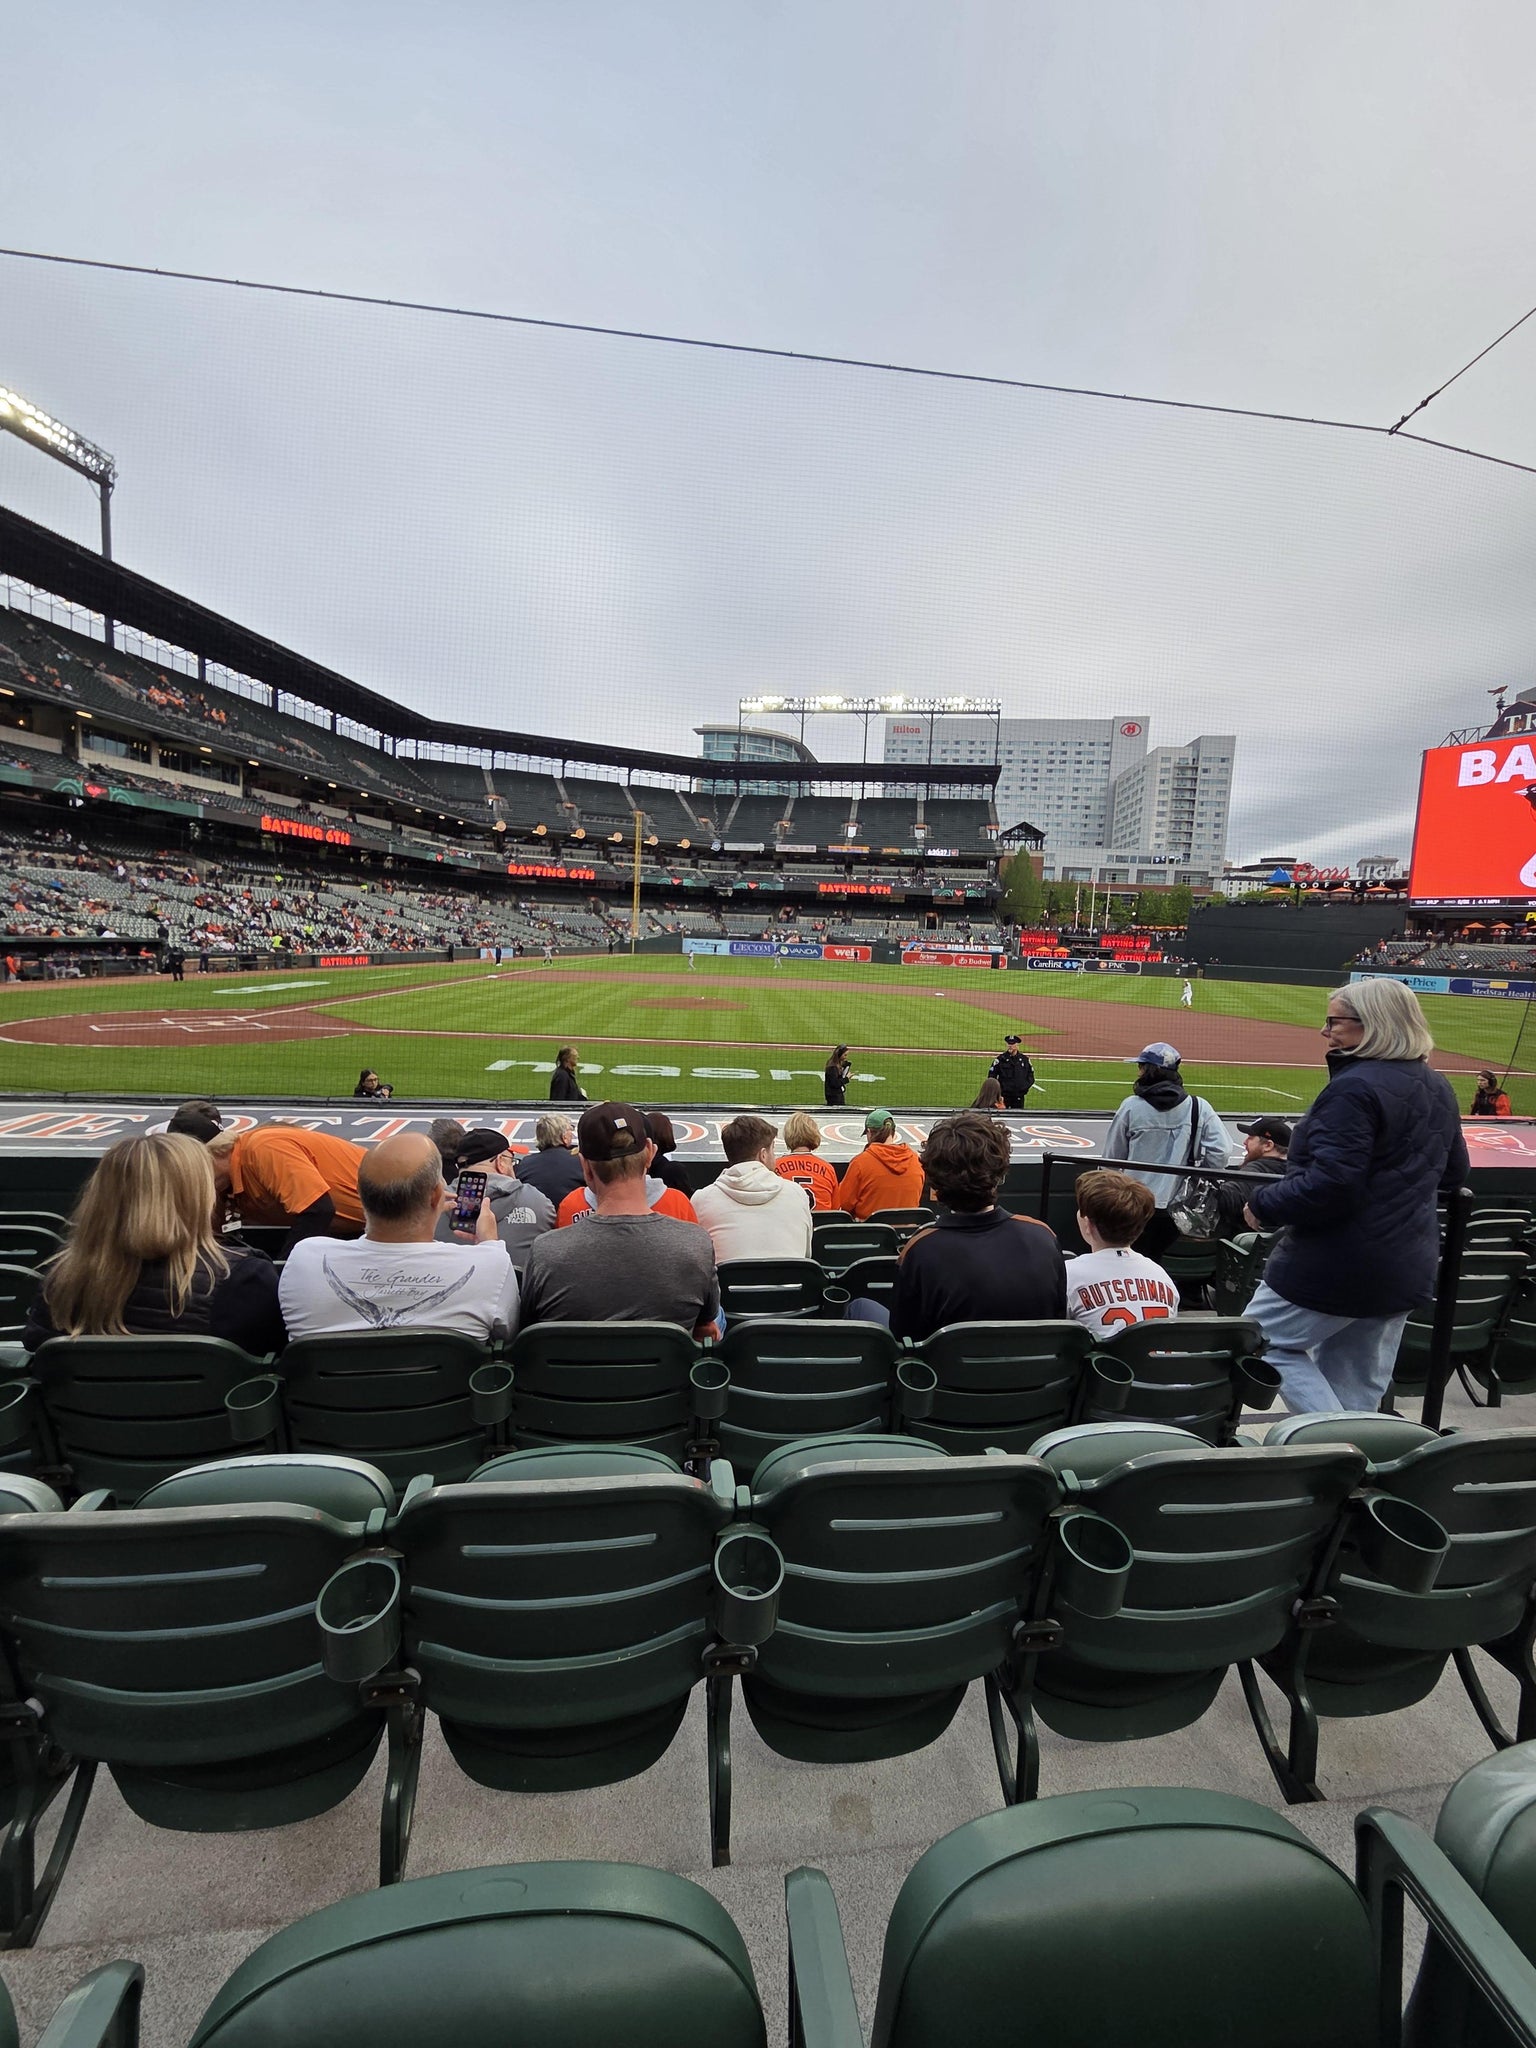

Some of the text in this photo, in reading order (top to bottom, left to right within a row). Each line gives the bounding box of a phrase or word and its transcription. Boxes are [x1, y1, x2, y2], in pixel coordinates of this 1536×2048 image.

[893, 725, 921, 734] Hilton
[261, 815, 351, 846] BATTING 6TH
[507, 864, 595, 880] BATTING 6TH
[1292, 862, 1350, 881] Coors
[818, 883, 892, 895] BATTING 6TH
[1289, 880, 1386, 889] ROOF DECK
[733, 943, 771, 952] LECOM
[1101, 940, 1134, 948] BATTING
[320, 955, 369, 967] BATTING 6TH
[1033, 960, 1063, 969] CareFirst
[1108, 962, 1126, 970] PNC
[1472, 988, 1507, 997] MedStar
[775, 1160, 827, 1176] ROBINSON
[361, 1268, 381, 1283] The
[1077, 1278, 1174, 1312] RUTSCHMAN
